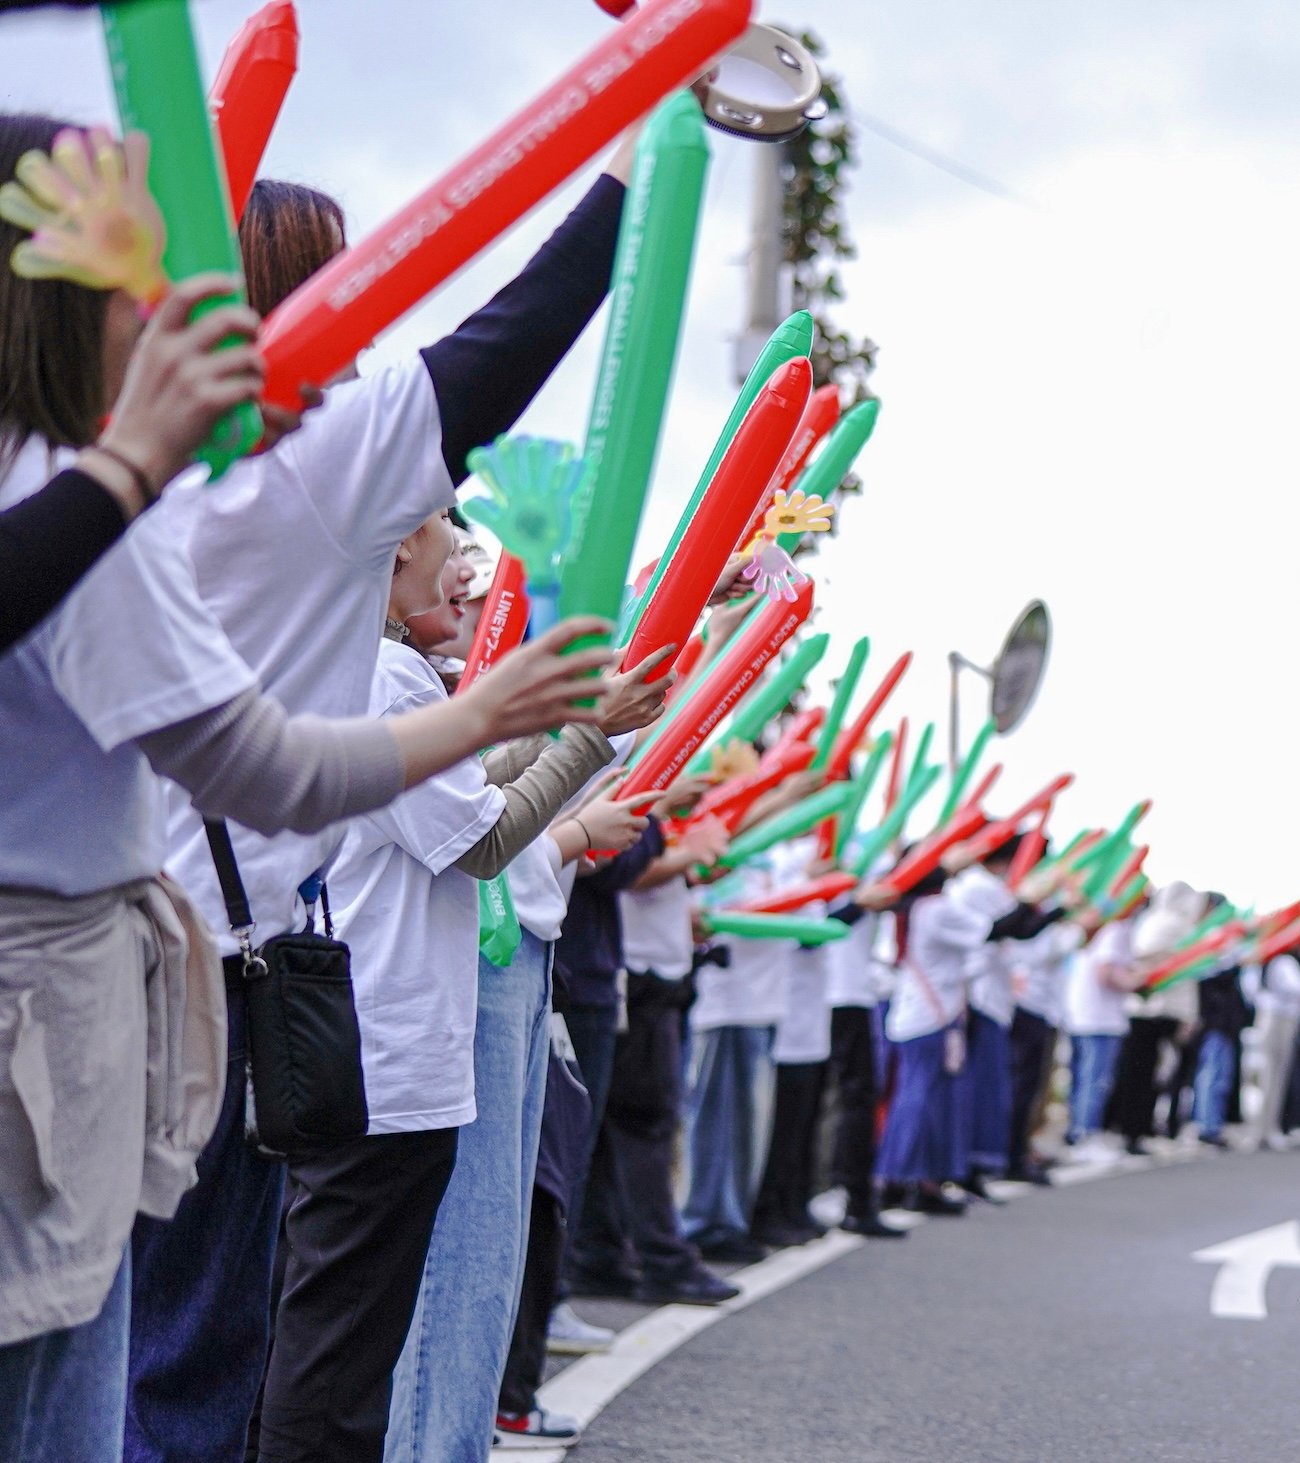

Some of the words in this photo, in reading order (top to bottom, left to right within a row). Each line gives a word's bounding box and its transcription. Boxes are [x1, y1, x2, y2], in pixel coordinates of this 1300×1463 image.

[584, 51, 636, 96] THE
[449, 86, 589, 210] CHALLENGES
[631, 152, 658, 226] ENJOY
[621, 229, 644, 277] THE
[589, 278, 635, 430] CHALLENGES
[769, 613, 799, 649] ENJOY
[751, 649, 771, 672] THE
[697, 669, 754, 736] CHALLENGES
